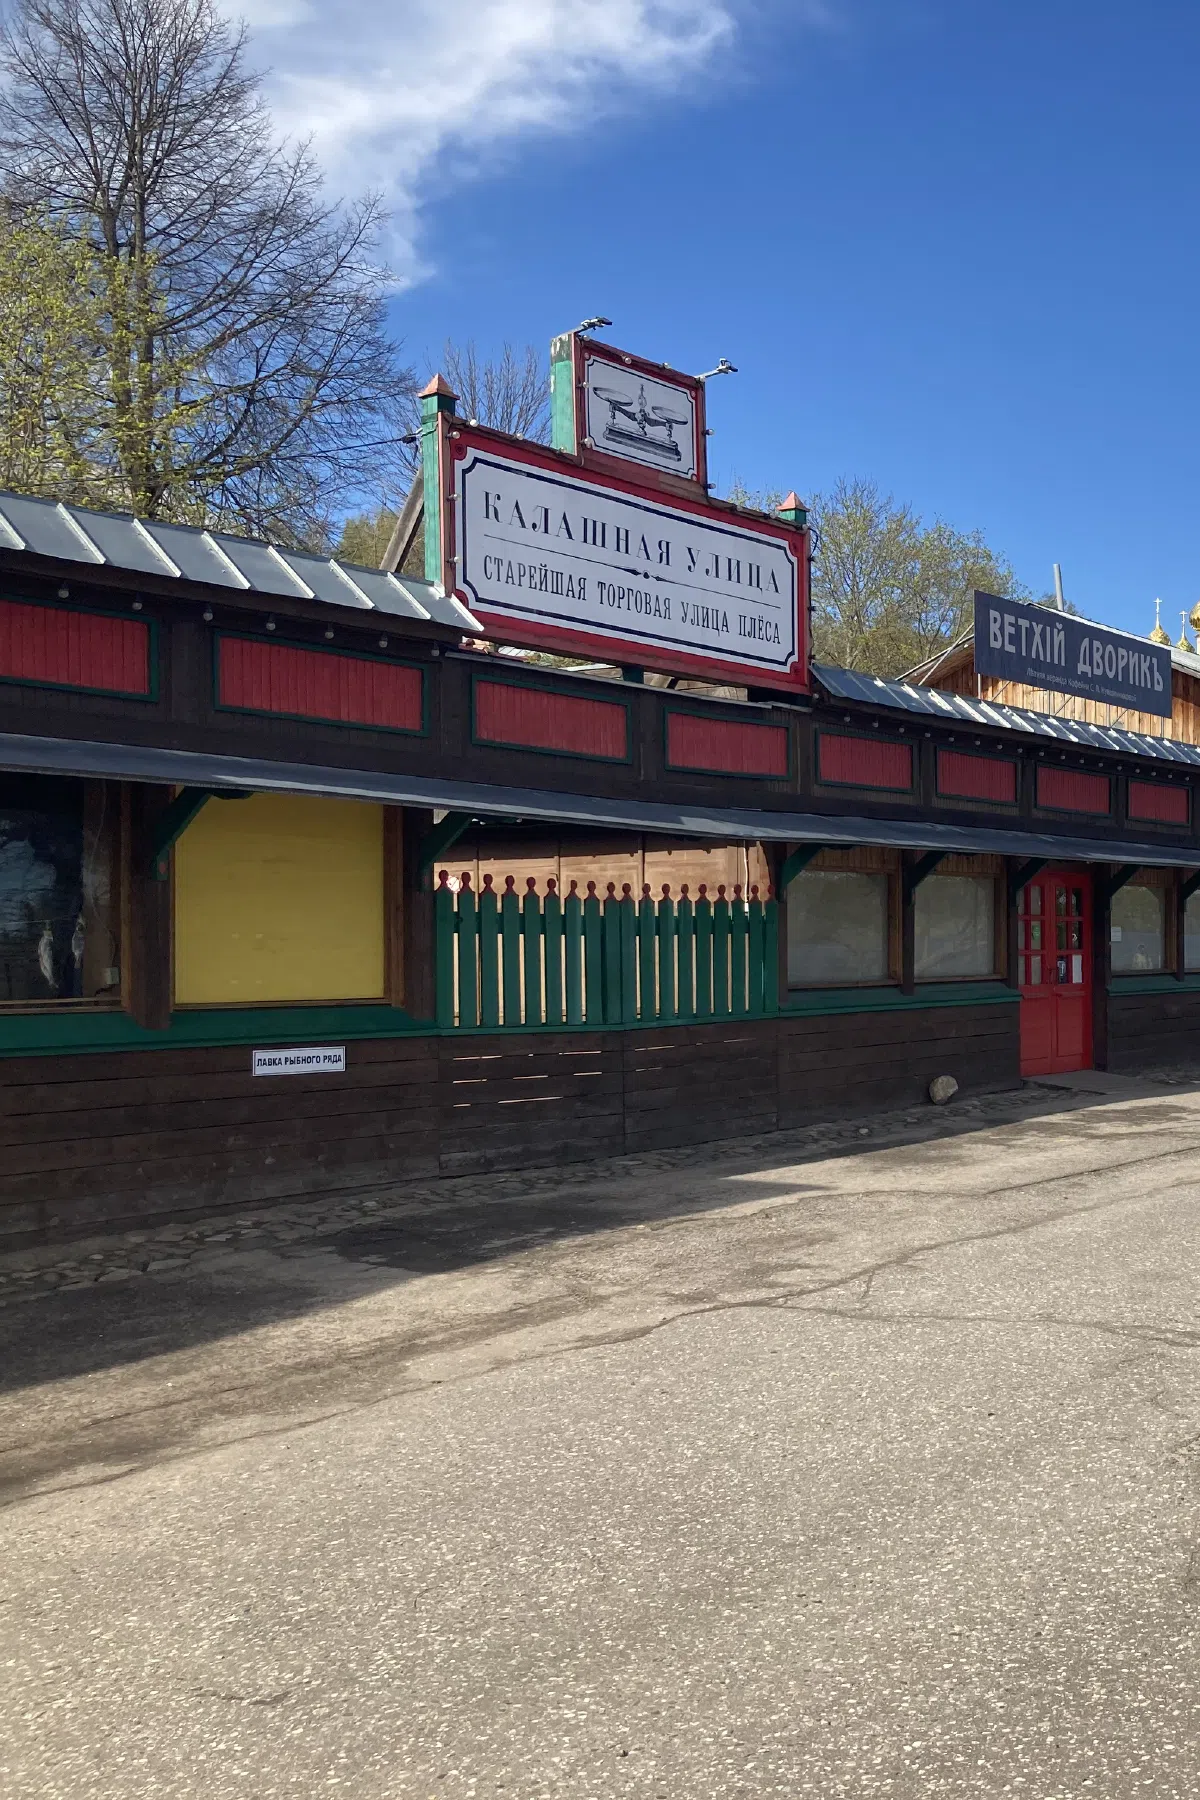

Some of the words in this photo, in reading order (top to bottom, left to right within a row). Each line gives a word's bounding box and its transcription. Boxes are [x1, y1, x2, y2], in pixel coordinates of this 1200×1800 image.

[482, 490, 672, 567] КАЛАШНАЯ
[686, 545, 781, 595] УЛИЦА
[483, 554, 587, 602] СТАРЕЙШАЯ
[597, 581, 672, 621] ТОРГОВАЯ
[680, 601, 729, 637] УЛИЦА
[738, 614, 781, 645] ПЛЁСА
[1077, 637, 1164, 692] ДВОРИКЪ
[256, 1057, 282, 1067] ЛАВКА
[284, 1055, 321, 1065] РЫБНОГО
[322, 1054, 342, 1064] РЯДА
